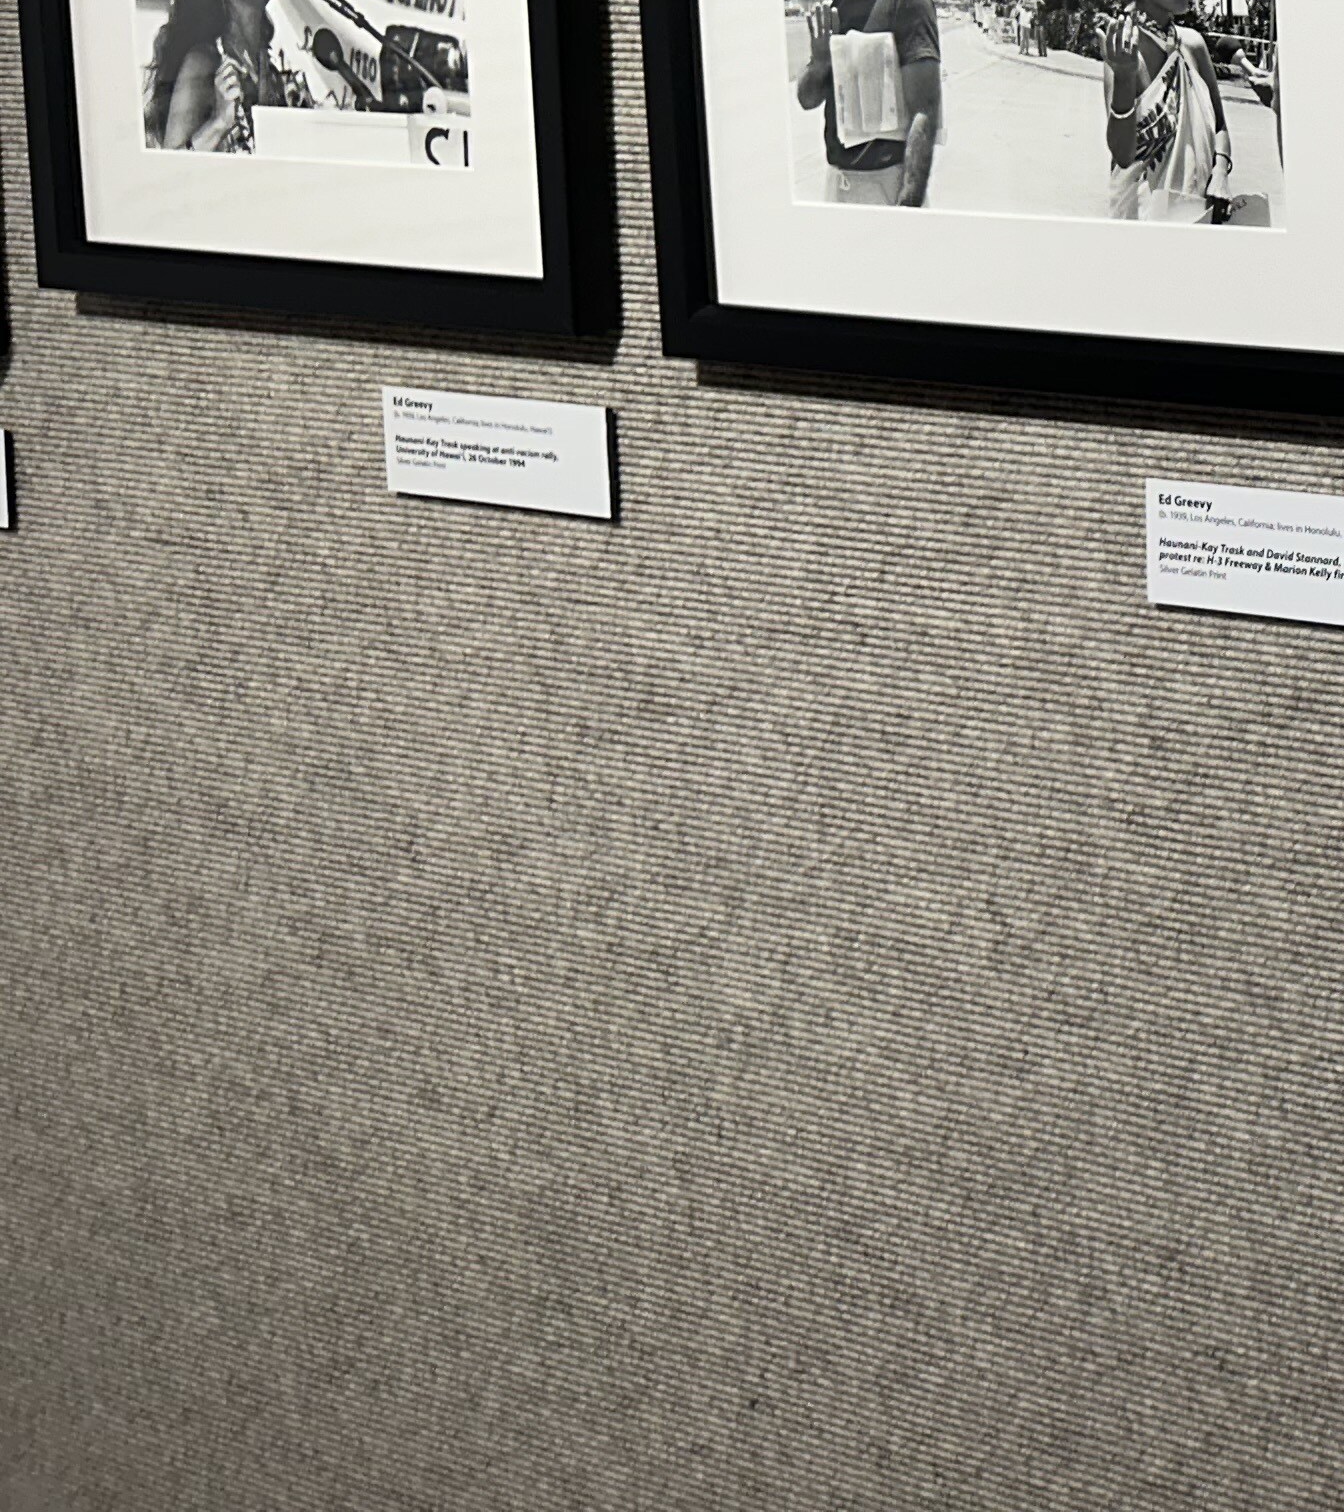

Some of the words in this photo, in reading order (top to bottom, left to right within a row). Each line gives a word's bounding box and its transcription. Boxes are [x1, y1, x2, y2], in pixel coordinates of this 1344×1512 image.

[393, 396, 403, 407] Ed
[404, 398, 433, 412] Greevy
[1159, 493, 1172, 505] Ed
[1174, 495, 1212, 512] Greevy
[1190, 513, 1202, 523] Los
[1220, 544, 1244, 555] Trask
[1246, 548, 1265, 558] and
[1266, 549, 1295, 561] David
[1159, 552, 1192, 562] protest
[1224, 557, 1263, 573] Freeway
[1264, 562, 1272, 571] &
[1274, 562, 1307, 576] Marion
[1309, 567, 1332, 581] Kelly
